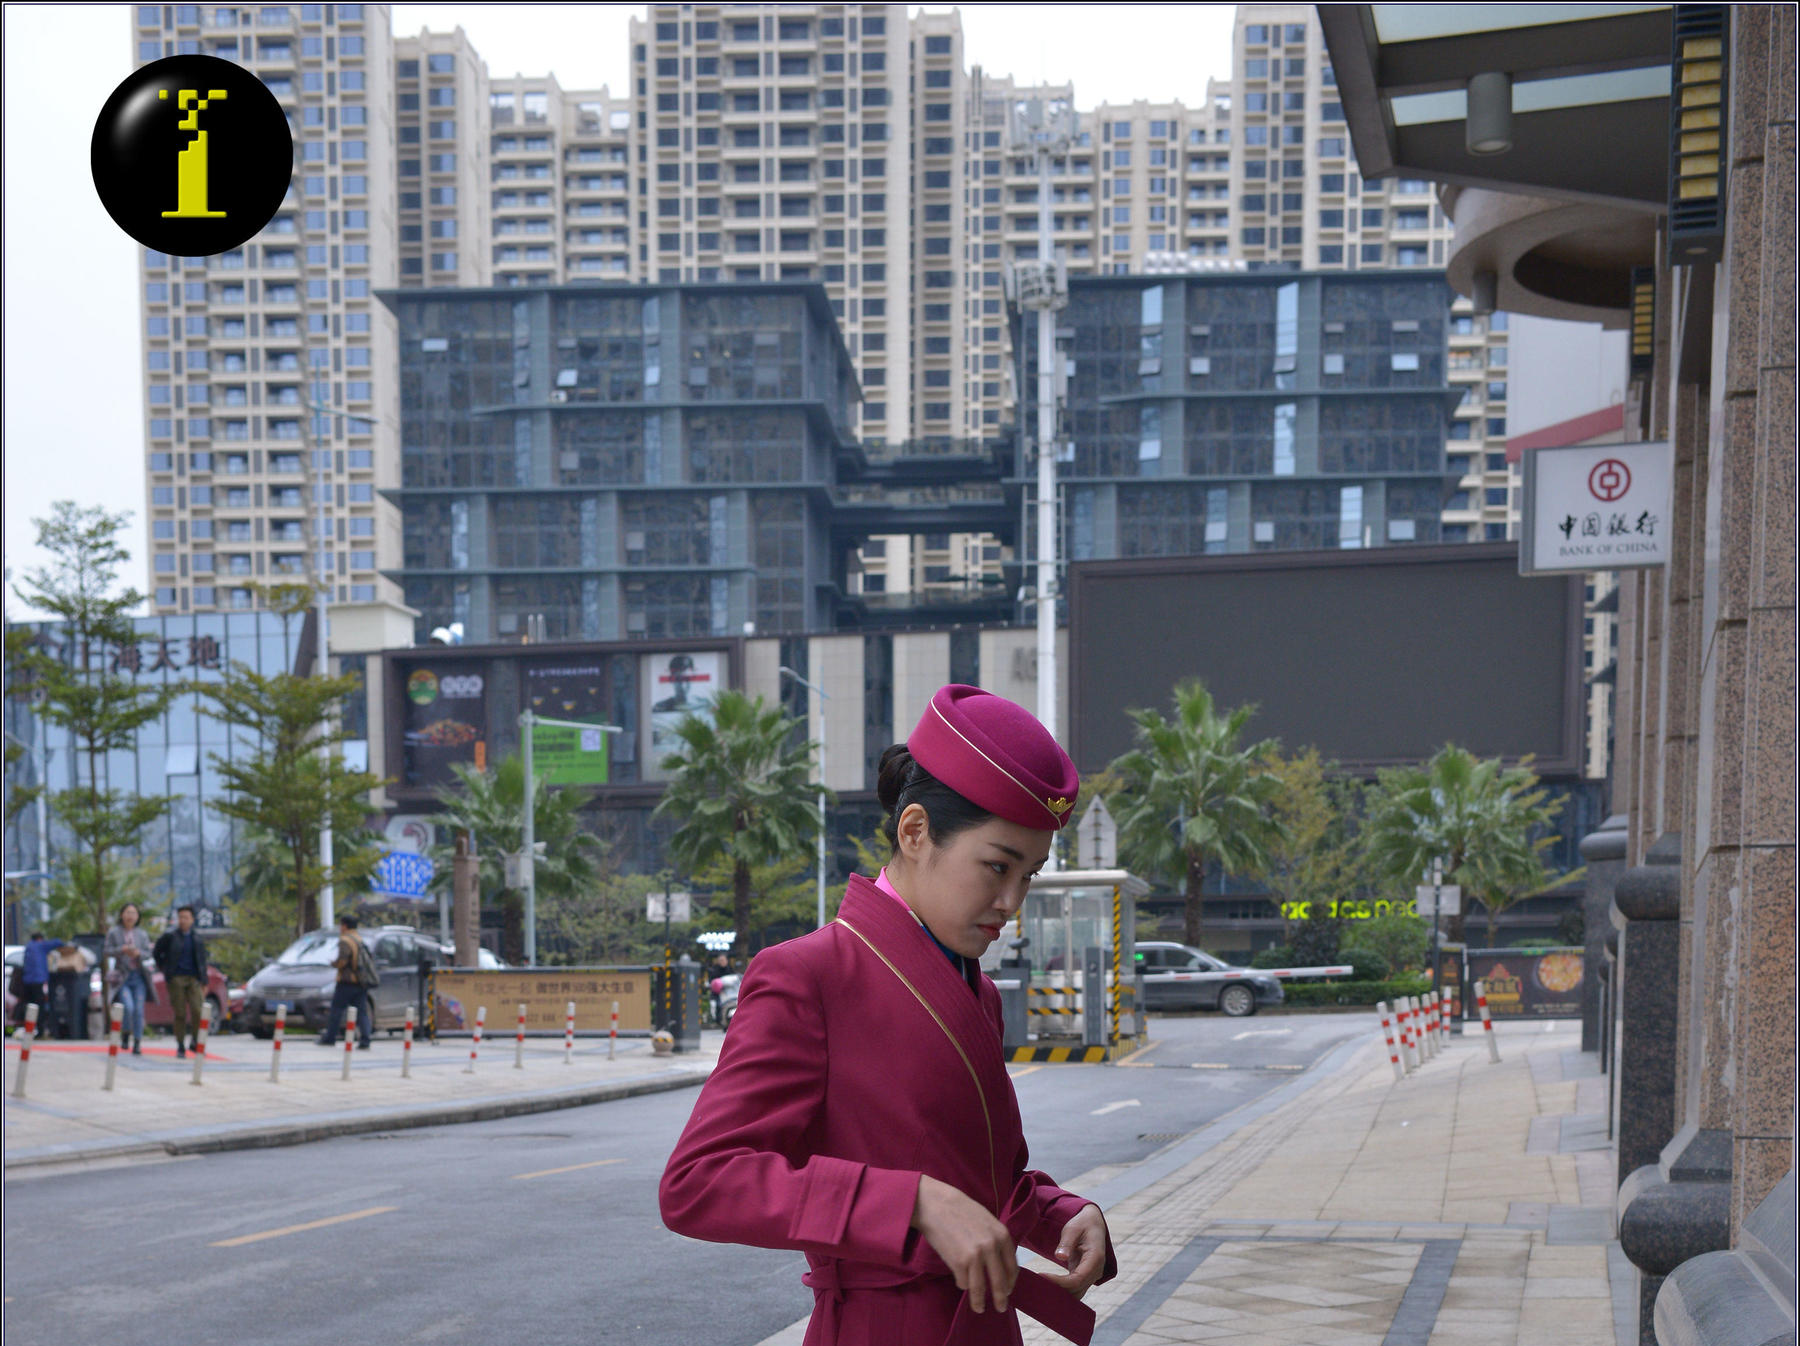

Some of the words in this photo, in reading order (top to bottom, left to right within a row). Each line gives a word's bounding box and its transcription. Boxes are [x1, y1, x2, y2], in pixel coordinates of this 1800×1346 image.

[1559, 510, 1659, 541] 中国银行
[1559, 545, 1593, 556] BANK
[1597, 544, 1612, 554] OF
[1616, 542, 1658, 554] CHINA
